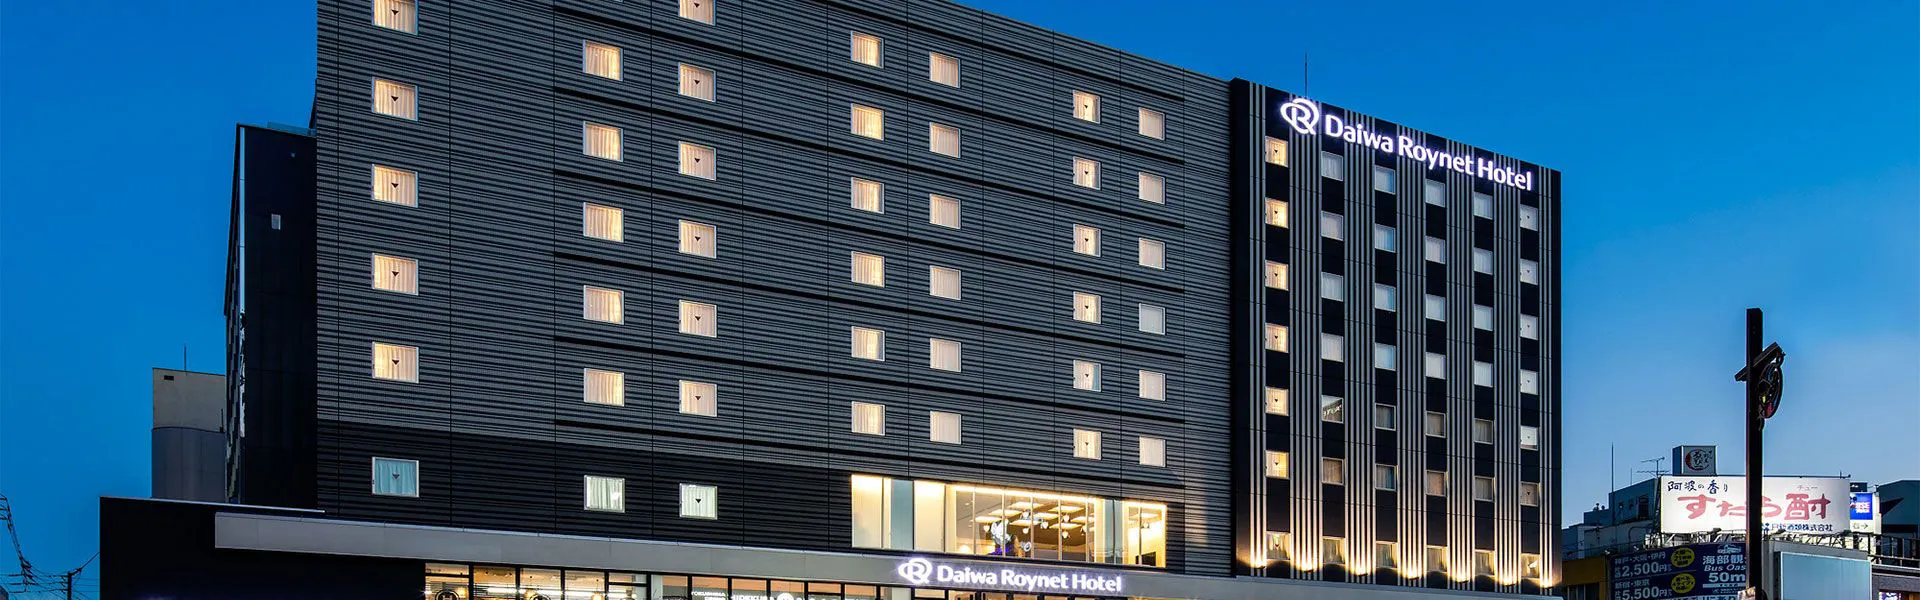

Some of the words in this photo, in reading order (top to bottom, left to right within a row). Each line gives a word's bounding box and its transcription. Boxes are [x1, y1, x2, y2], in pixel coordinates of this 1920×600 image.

[1324, 113, 1394, 154] Daiwa
[1398, 134, 1475, 177] Roynet
[1477, 157, 1533, 191] Hotel
[1667, 479, 1729, 495] 阿波の香り
[1702, 554, 1748, 566] 海部観
[1704, 564, 1723, 572] Bus
[1726, 563, 1747, 571] Oas
[936, 565, 998, 585] Daiwa
[1001, 571, 1070, 592] Roynet
[1073, 574, 1123, 593] Hotel
[1708, 572, 1746, 583] 50m
